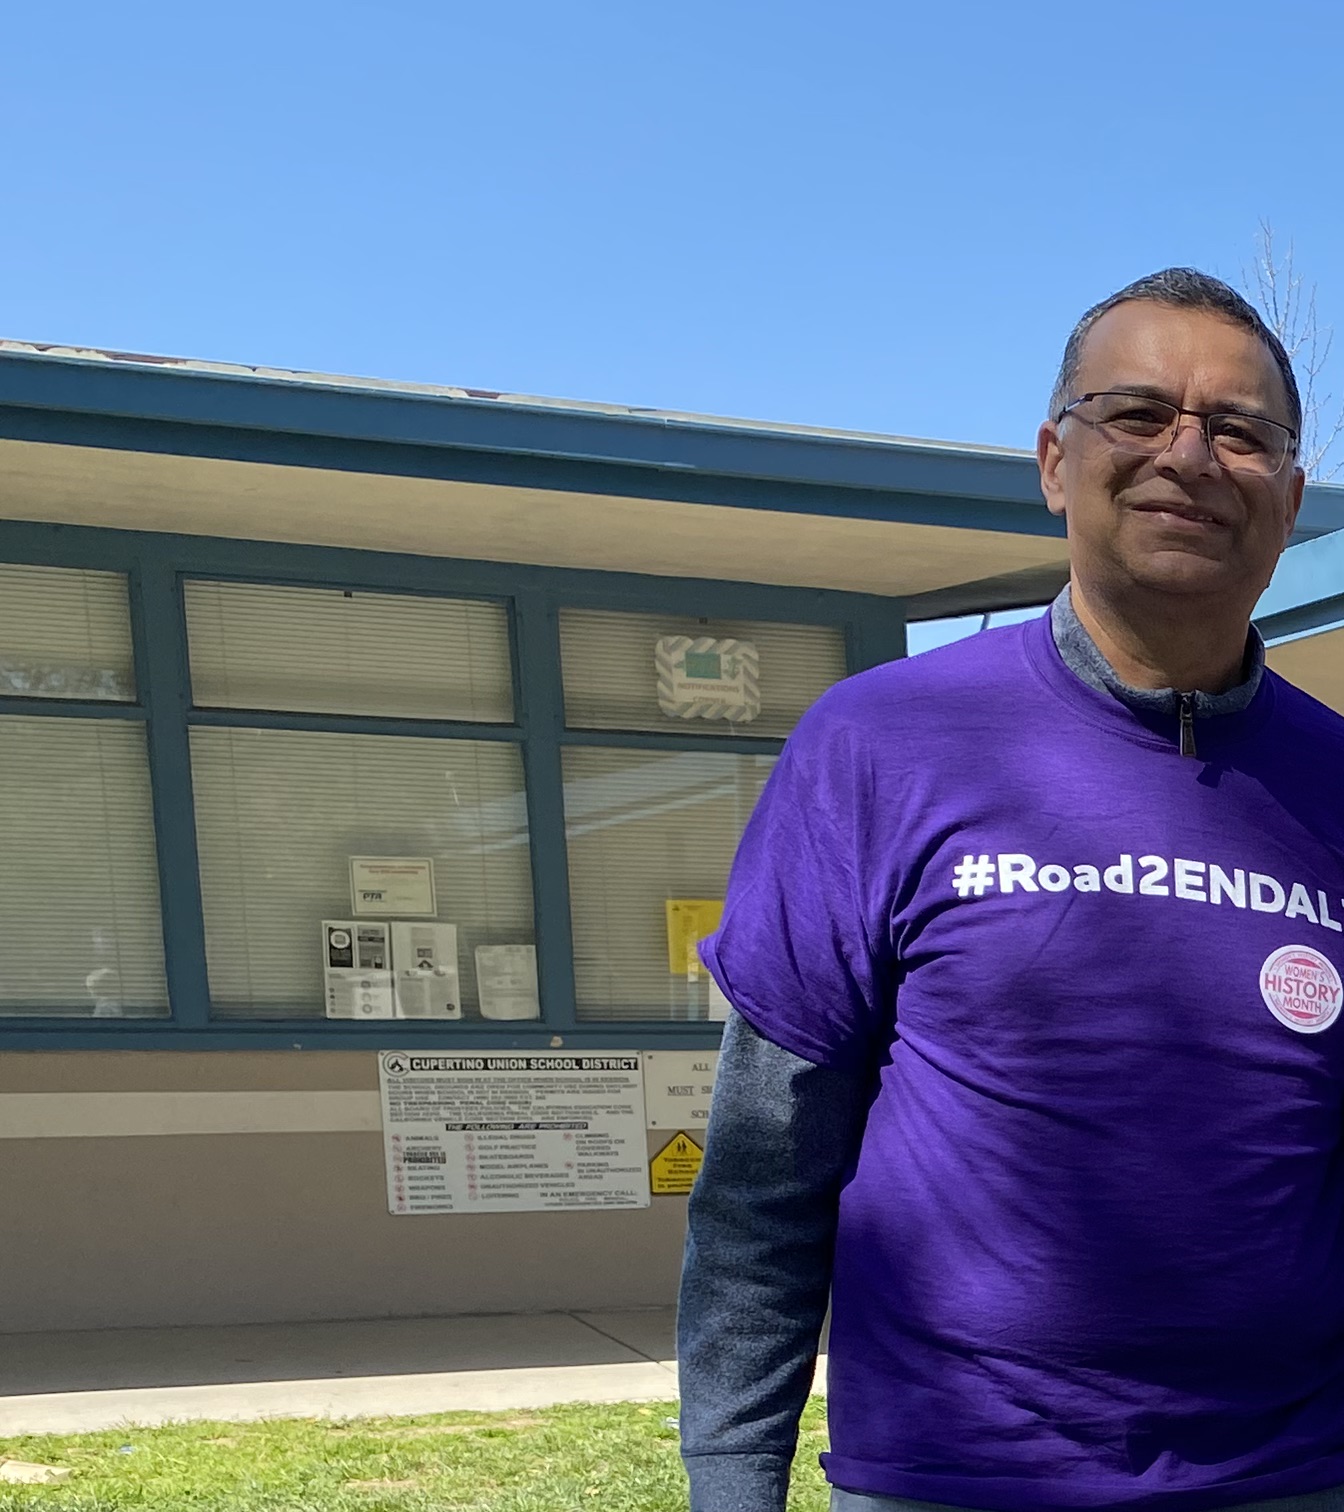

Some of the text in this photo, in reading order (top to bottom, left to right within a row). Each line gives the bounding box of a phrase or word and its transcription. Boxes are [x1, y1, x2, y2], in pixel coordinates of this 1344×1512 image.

[1284, 964, 1325, 982] WOMEN'S
[1264, 973, 1340, 1003] HISTORY
[1283, 997, 1322, 1013] MONTH
[412, 1058, 484, 1070] CUPERTINO
[487, 1058, 527, 1070] UNION
[530, 1058, 579, 1070] SCHOOL
[582, 1058, 637, 1070] DISTRICT
[692, 1063, 711, 1071] ALL
[667, 1086, 713, 1095] MUST SI
[691, 1110, 709, 1118] SCH
